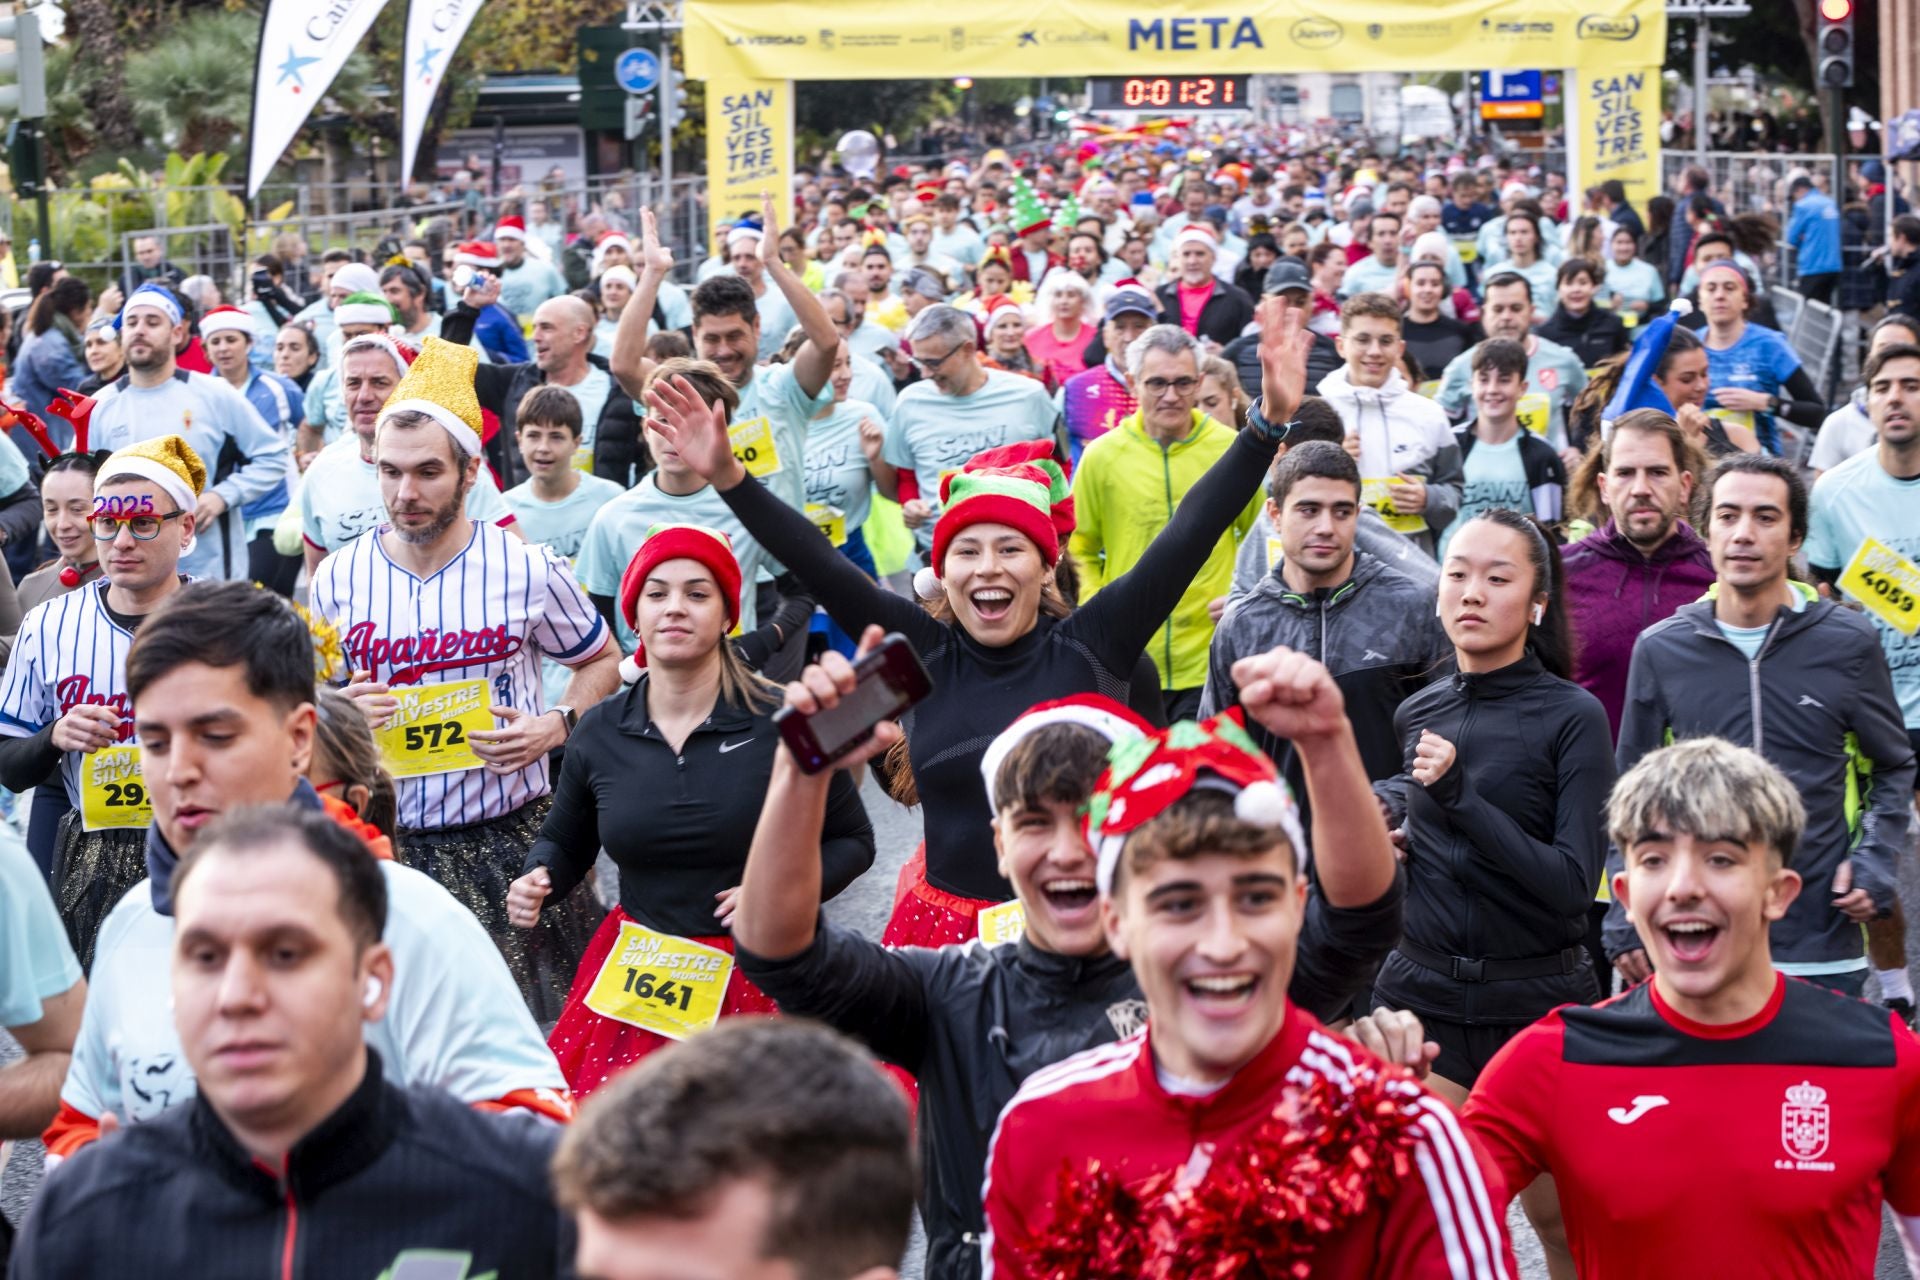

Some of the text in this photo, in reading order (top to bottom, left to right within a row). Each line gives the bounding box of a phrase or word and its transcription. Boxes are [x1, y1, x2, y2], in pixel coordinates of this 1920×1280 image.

[306, 0, 353, 41] Cai
[749, 35, 808, 45] VERDAD
[1128, 17, 1264, 50] META
[1124, 78, 1236, 106] 0:01:21
[1591, 72, 1644, 98] SAN
[722, 89, 773, 114] SAN
[1600, 95, 1634, 117] SIL
[731, 110, 765, 133] SIL
[1596, 112, 1642, 136] VES
[726, 128, 771, 151] VES
[1597, 133, 1643, 157] TRE
[727, 148, 773, 172] TRE
[93, 495, 154, 515] 2025
[1861, 570, 1915, 612] 4059
[344, 621, 513, 683] Apañeros
[383, 684, 481, 731] SILVESTRE
[395, 692, 421, 710] AN
[440, 701, 481, 722] MURCIA
[405, 721, 465, 751] 572
[92, 751, 132, 772] SAN
[103, 783, 152, 807] 29
[625, 936, 663, 954] SAN
[617, 951, 724, 973] SILVESTRE
[670, 970, 716, 983] MURCIA
[623, 967, 694, 1012] 1641
